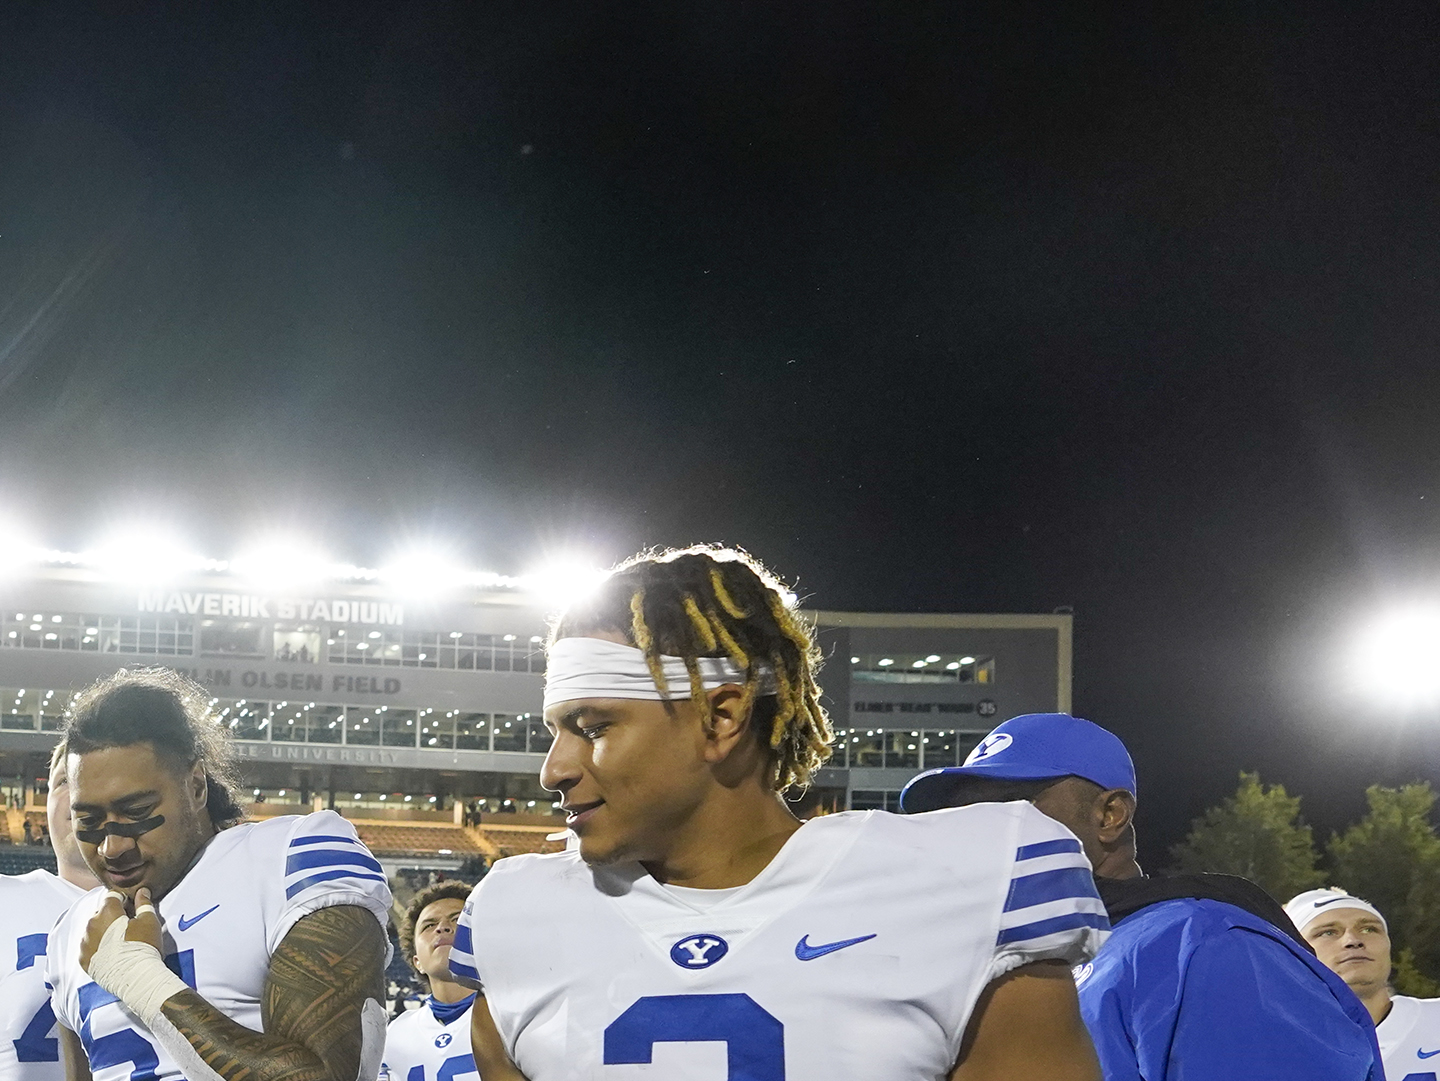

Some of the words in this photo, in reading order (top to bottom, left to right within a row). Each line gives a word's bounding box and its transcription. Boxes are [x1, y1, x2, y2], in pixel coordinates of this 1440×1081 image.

[137, 588, 271, 619] MAVERIK
[275, 598, 403, 626] STADIUM
[241, 670, 323, 692] OLSEN
[332, 675, 402, 695] FIELD
[271, 746, 399, 763] UNIVERSITY
